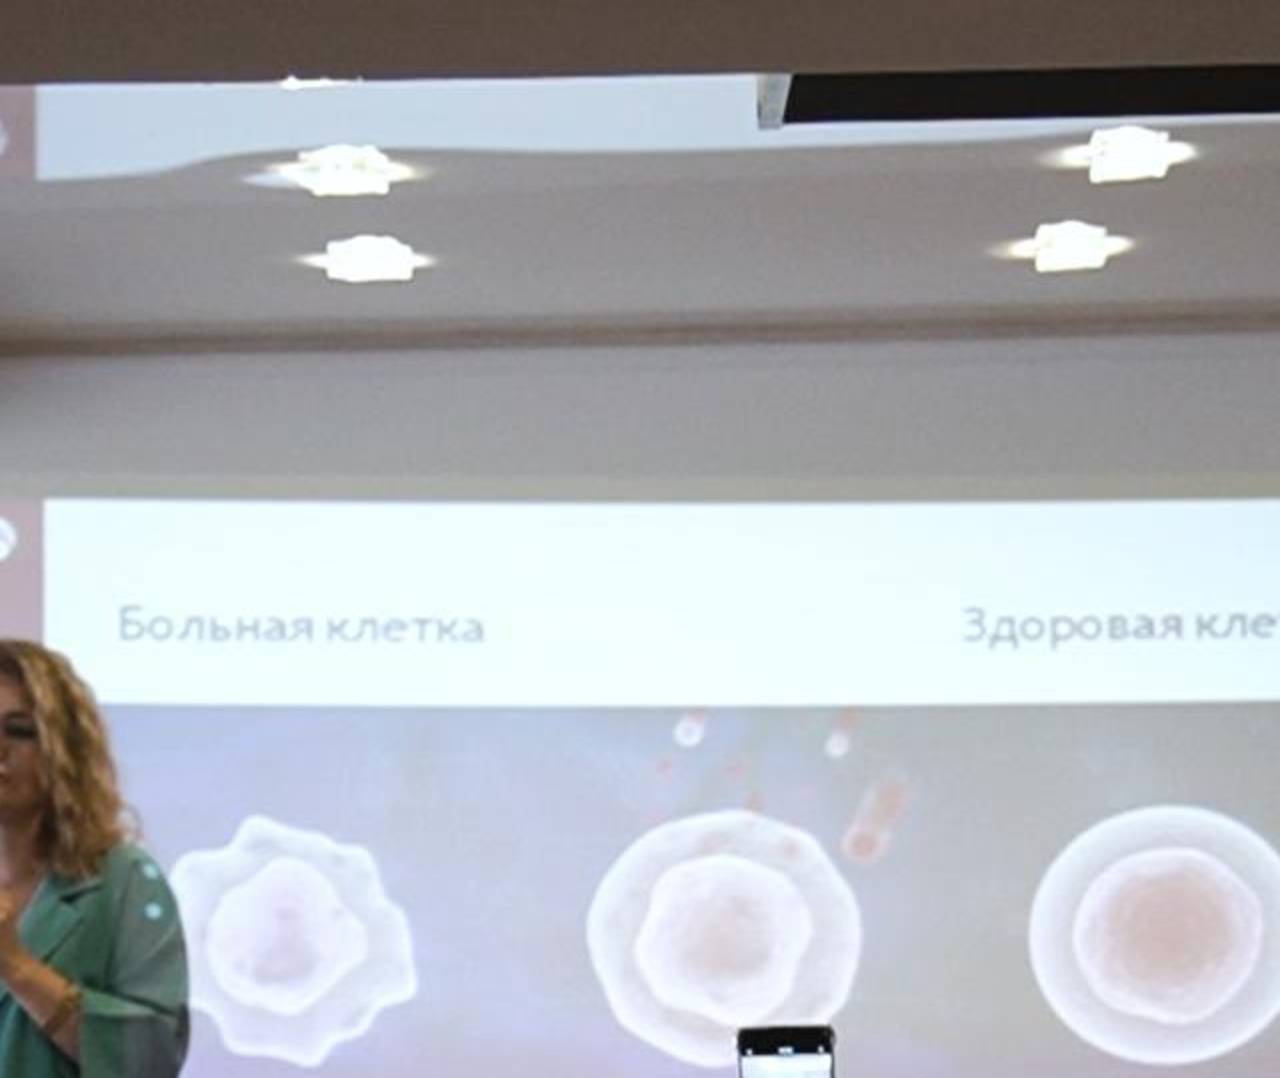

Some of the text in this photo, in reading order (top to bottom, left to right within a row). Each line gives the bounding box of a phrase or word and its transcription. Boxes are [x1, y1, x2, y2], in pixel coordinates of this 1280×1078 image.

[118, 603, 485, 644] Больная клетка
[962, 605, 1185, 651] Здоровая
